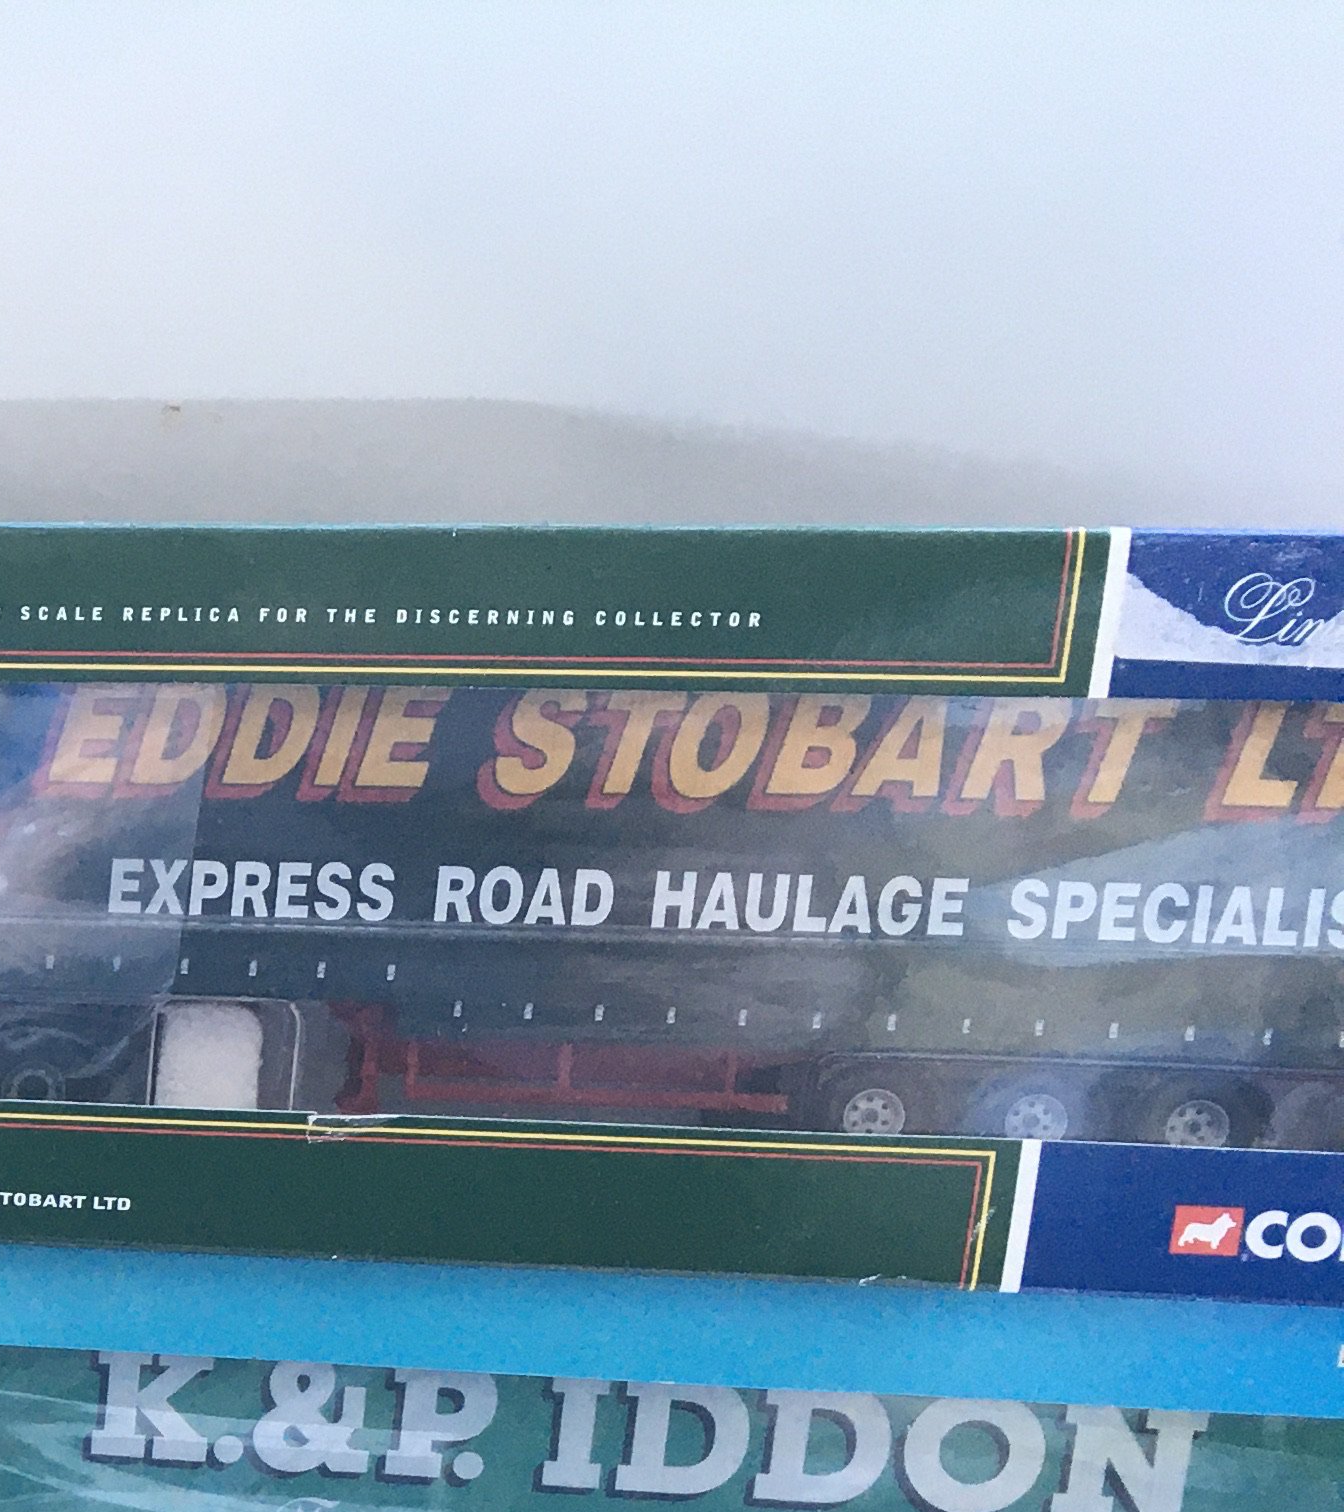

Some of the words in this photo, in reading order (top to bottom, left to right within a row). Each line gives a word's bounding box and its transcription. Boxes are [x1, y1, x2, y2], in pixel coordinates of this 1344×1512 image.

[19, 605, 106, 624] SCALE
[122, 607, 242, 624] REPLICA
[259, 608, 310, 625] FOR
[326, 608, 378, 626] THE
[396, 609, 576, 628] DISCERNING
[595, 610, 763, 629] COLLECTOR
[32, 684, 454, 806] EDDIE
[477, 688, 1179, 820] STOBART
[108, 857, 396, 921] EXPRESS
[433, 865, 615, 927] ROAD
[650, 870, 970, 937] HAULAGE
[92, 1194, 132, 1212] LTD
